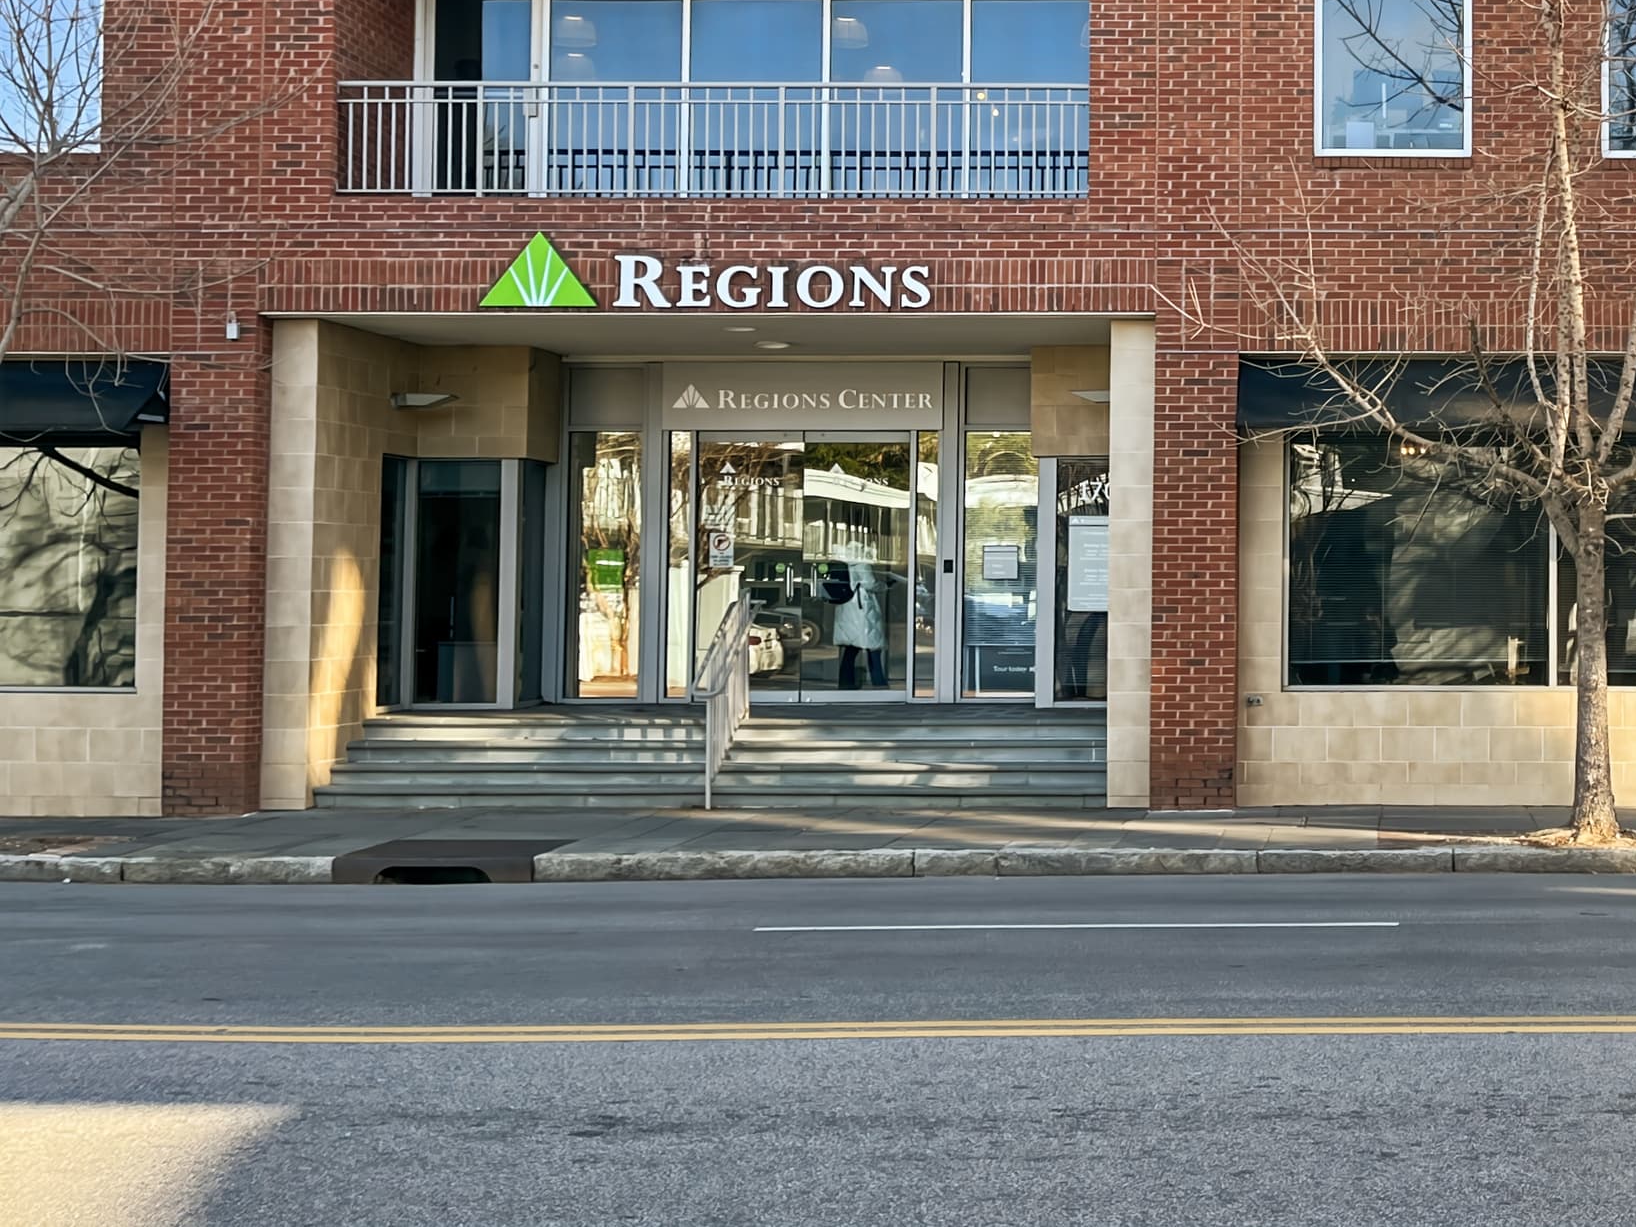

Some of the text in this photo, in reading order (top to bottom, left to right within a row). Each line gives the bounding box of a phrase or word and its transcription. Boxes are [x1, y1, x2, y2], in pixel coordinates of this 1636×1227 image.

[613, 254, 932, 309] REGIONS
[717, 388, 933, 410] REGIONS CENTER
